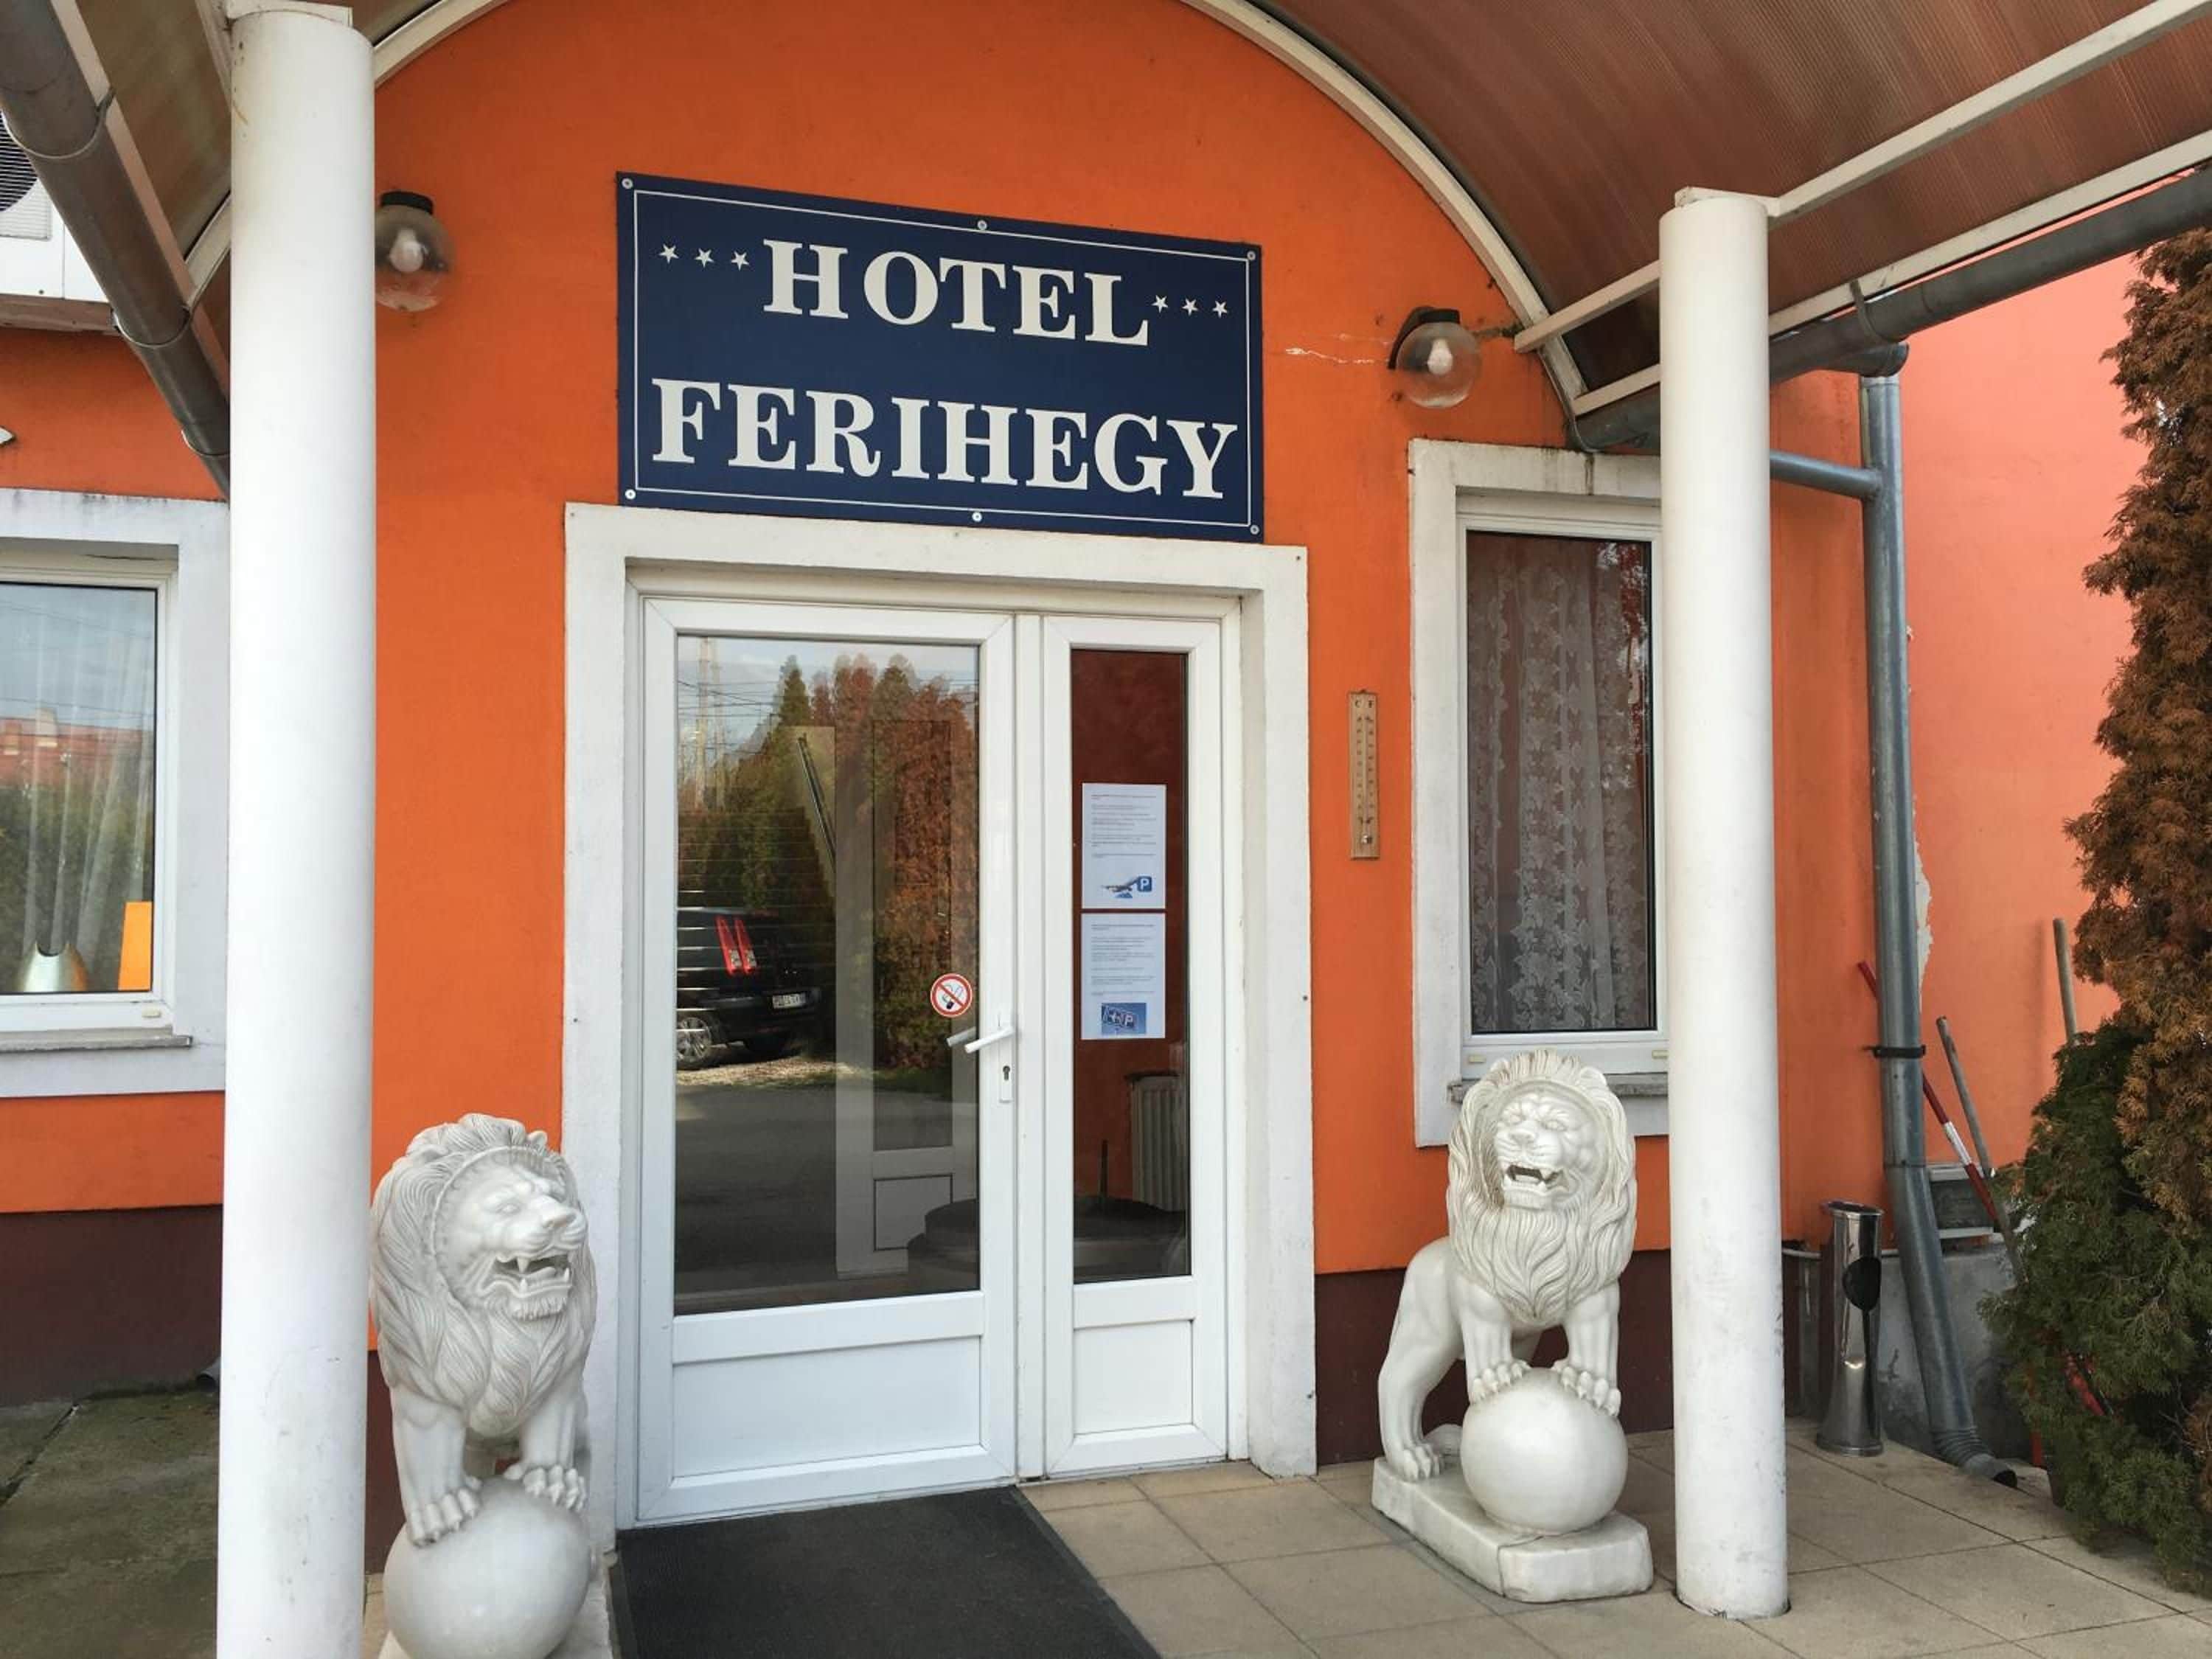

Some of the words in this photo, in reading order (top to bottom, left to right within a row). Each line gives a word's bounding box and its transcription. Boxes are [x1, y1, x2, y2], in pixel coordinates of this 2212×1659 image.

[764, 239, 1148, 347] HOTEL
[653, 378, 1238, 499] FERIHEGY
[1141, 878, 1149, 889] P
